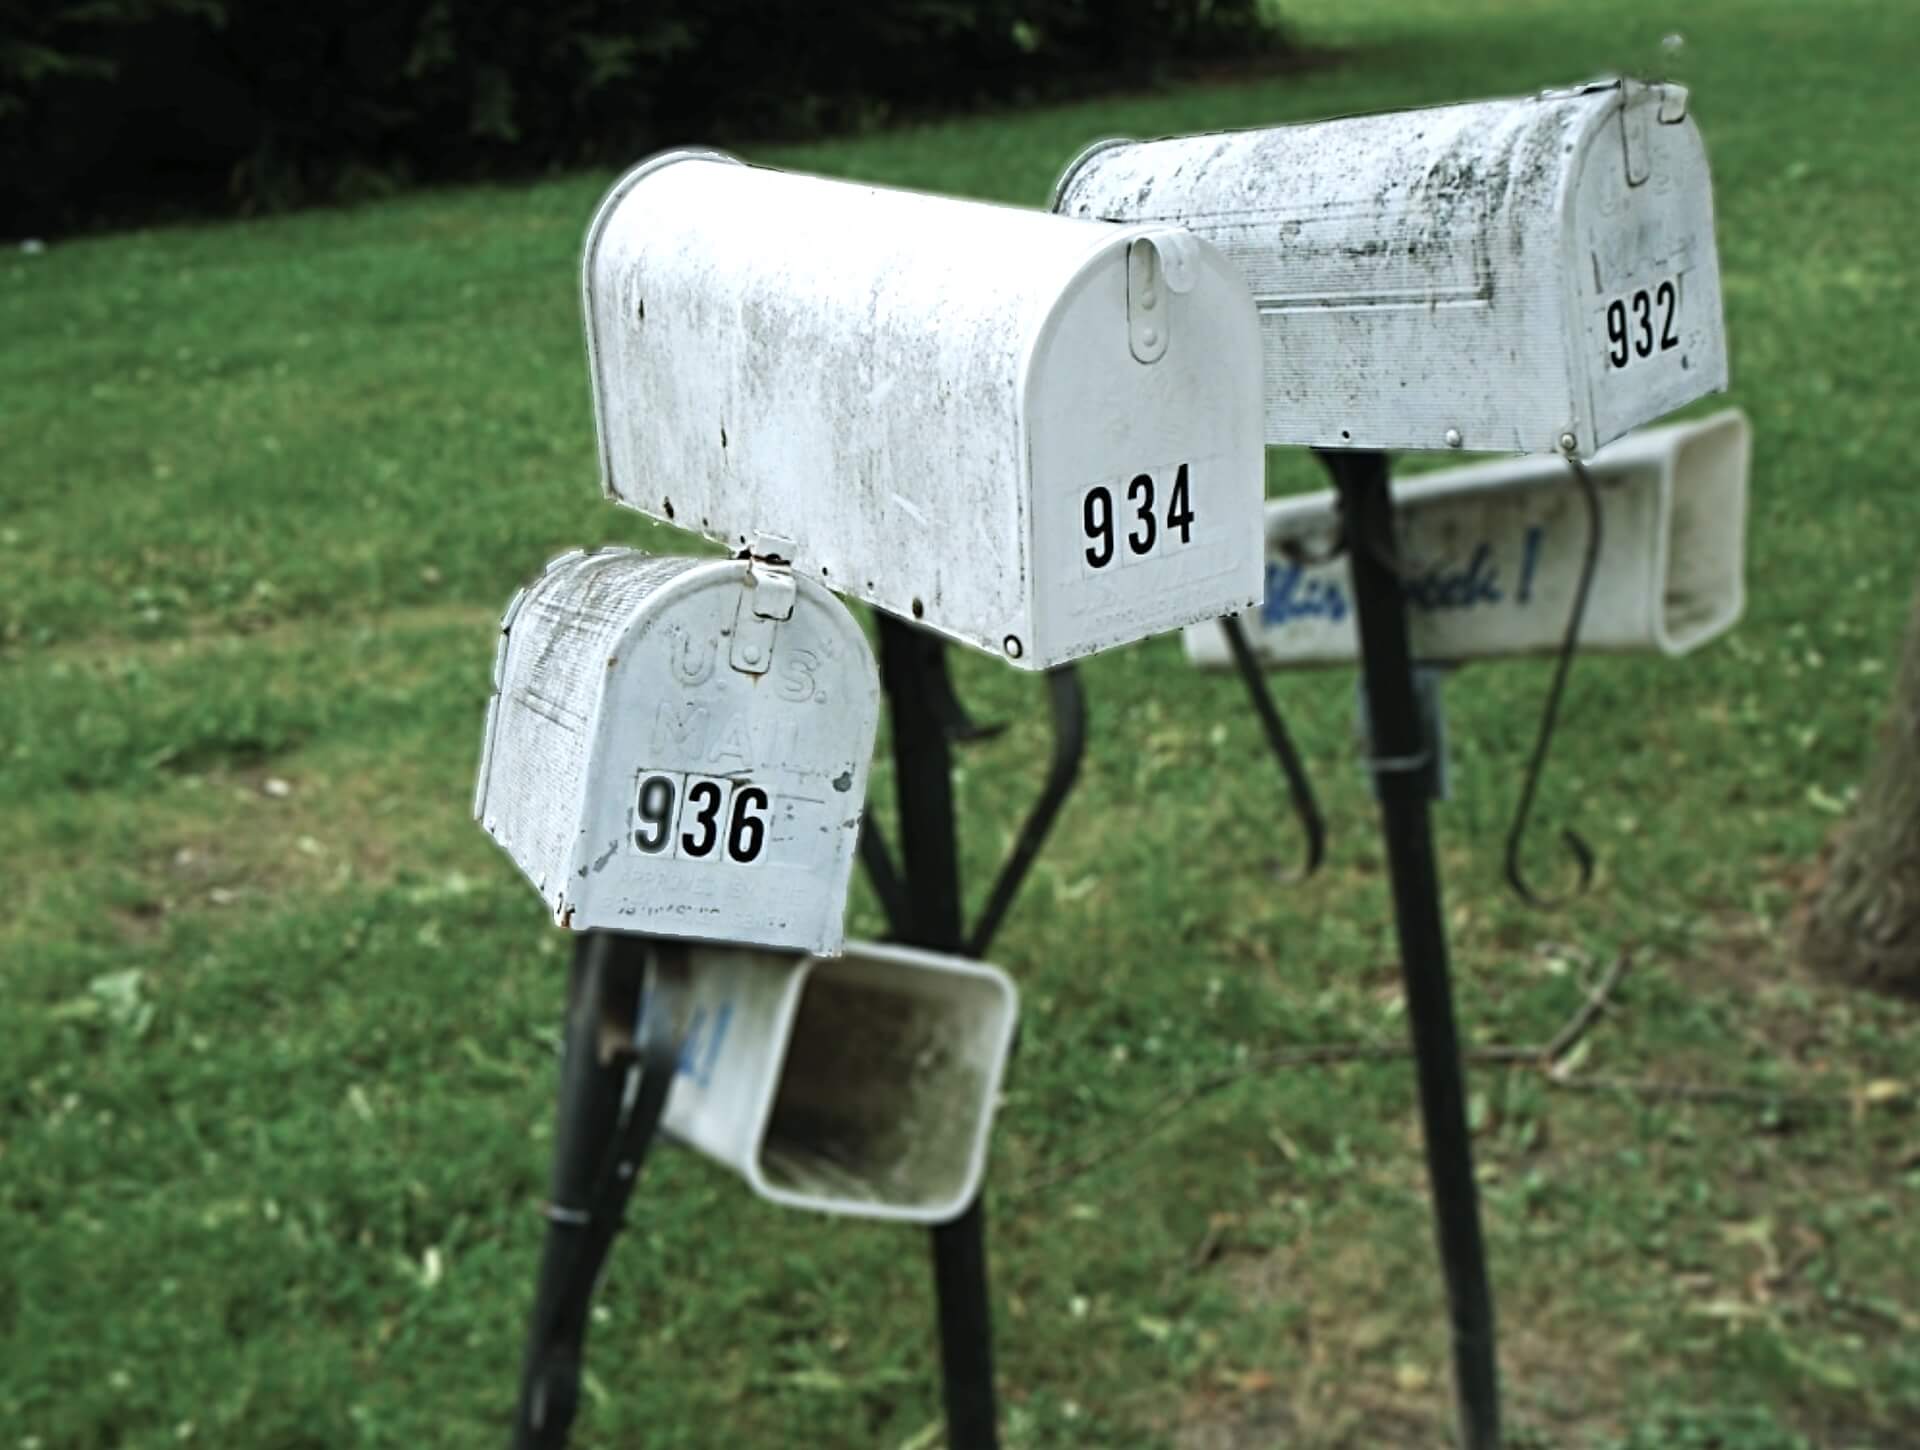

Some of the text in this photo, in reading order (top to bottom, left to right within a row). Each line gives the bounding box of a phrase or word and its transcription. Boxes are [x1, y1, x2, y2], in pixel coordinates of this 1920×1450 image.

[1607, 281, 1679, 368] 932
[1083, 463, 1195, 569] 934
[634, 775, 769, 864] 936
